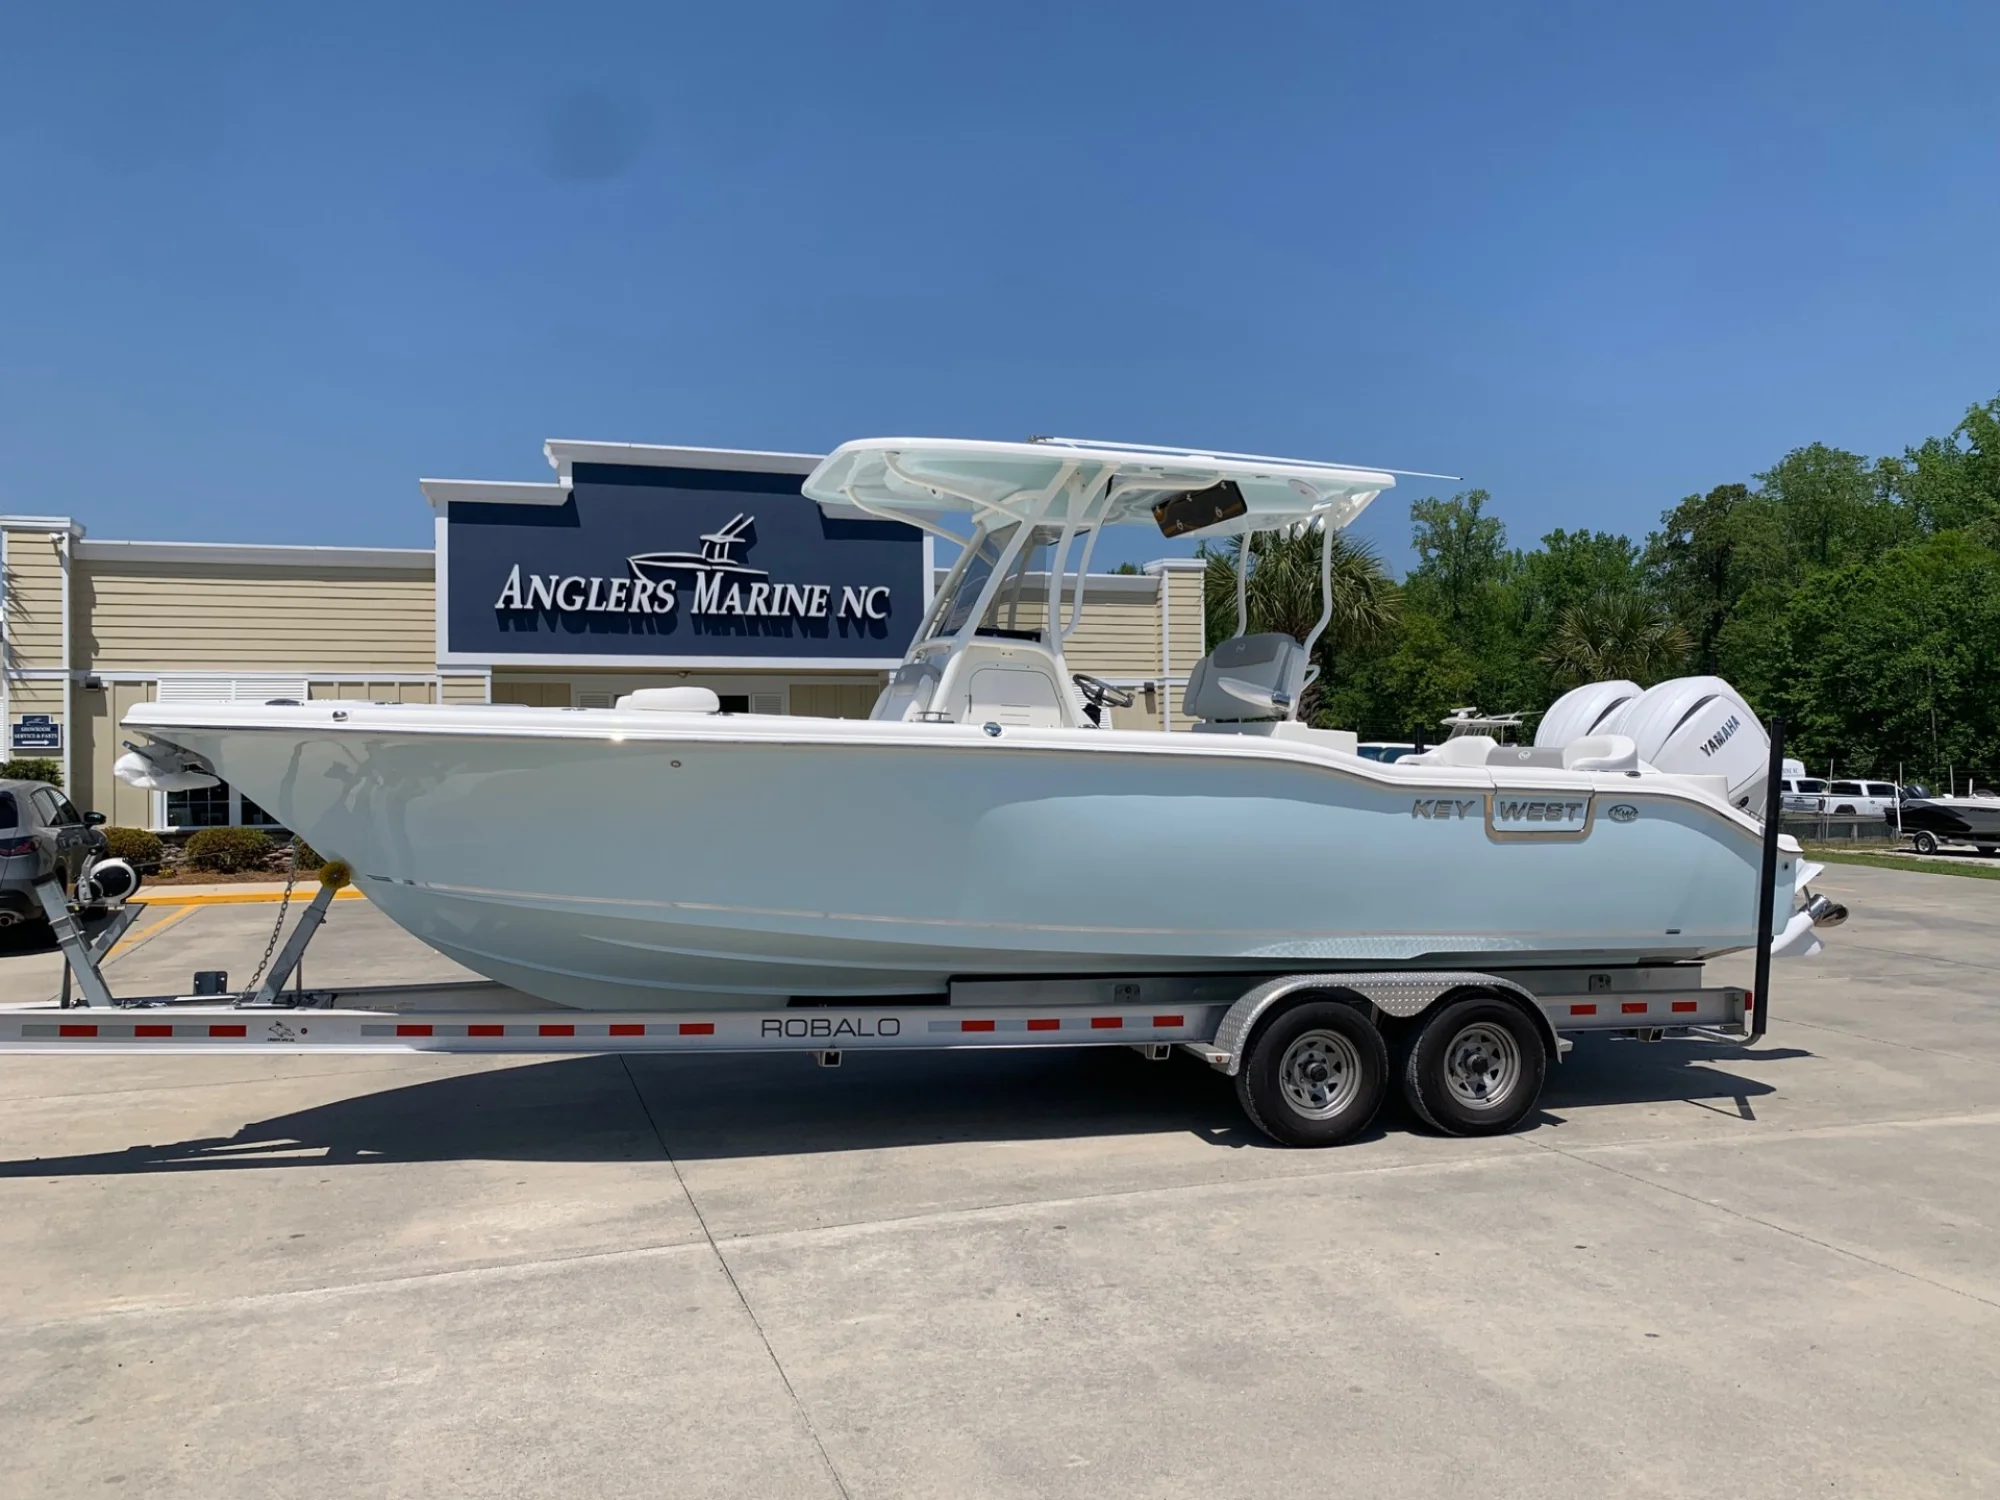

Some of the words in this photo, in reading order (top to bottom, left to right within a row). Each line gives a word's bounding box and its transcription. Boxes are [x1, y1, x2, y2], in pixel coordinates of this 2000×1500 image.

[495, 564, 676, 613] ANGLERS
[691, 571, 831, 617] MARINE
[837, 585, 891, 619] NC
[1700, 715, 1741, 757] YAMAHA
[1411, 799, 1475, 820] KEY
[1500, 801, 1582, 822] WEST
[761, 1018, 900, 1038] ROBALO
